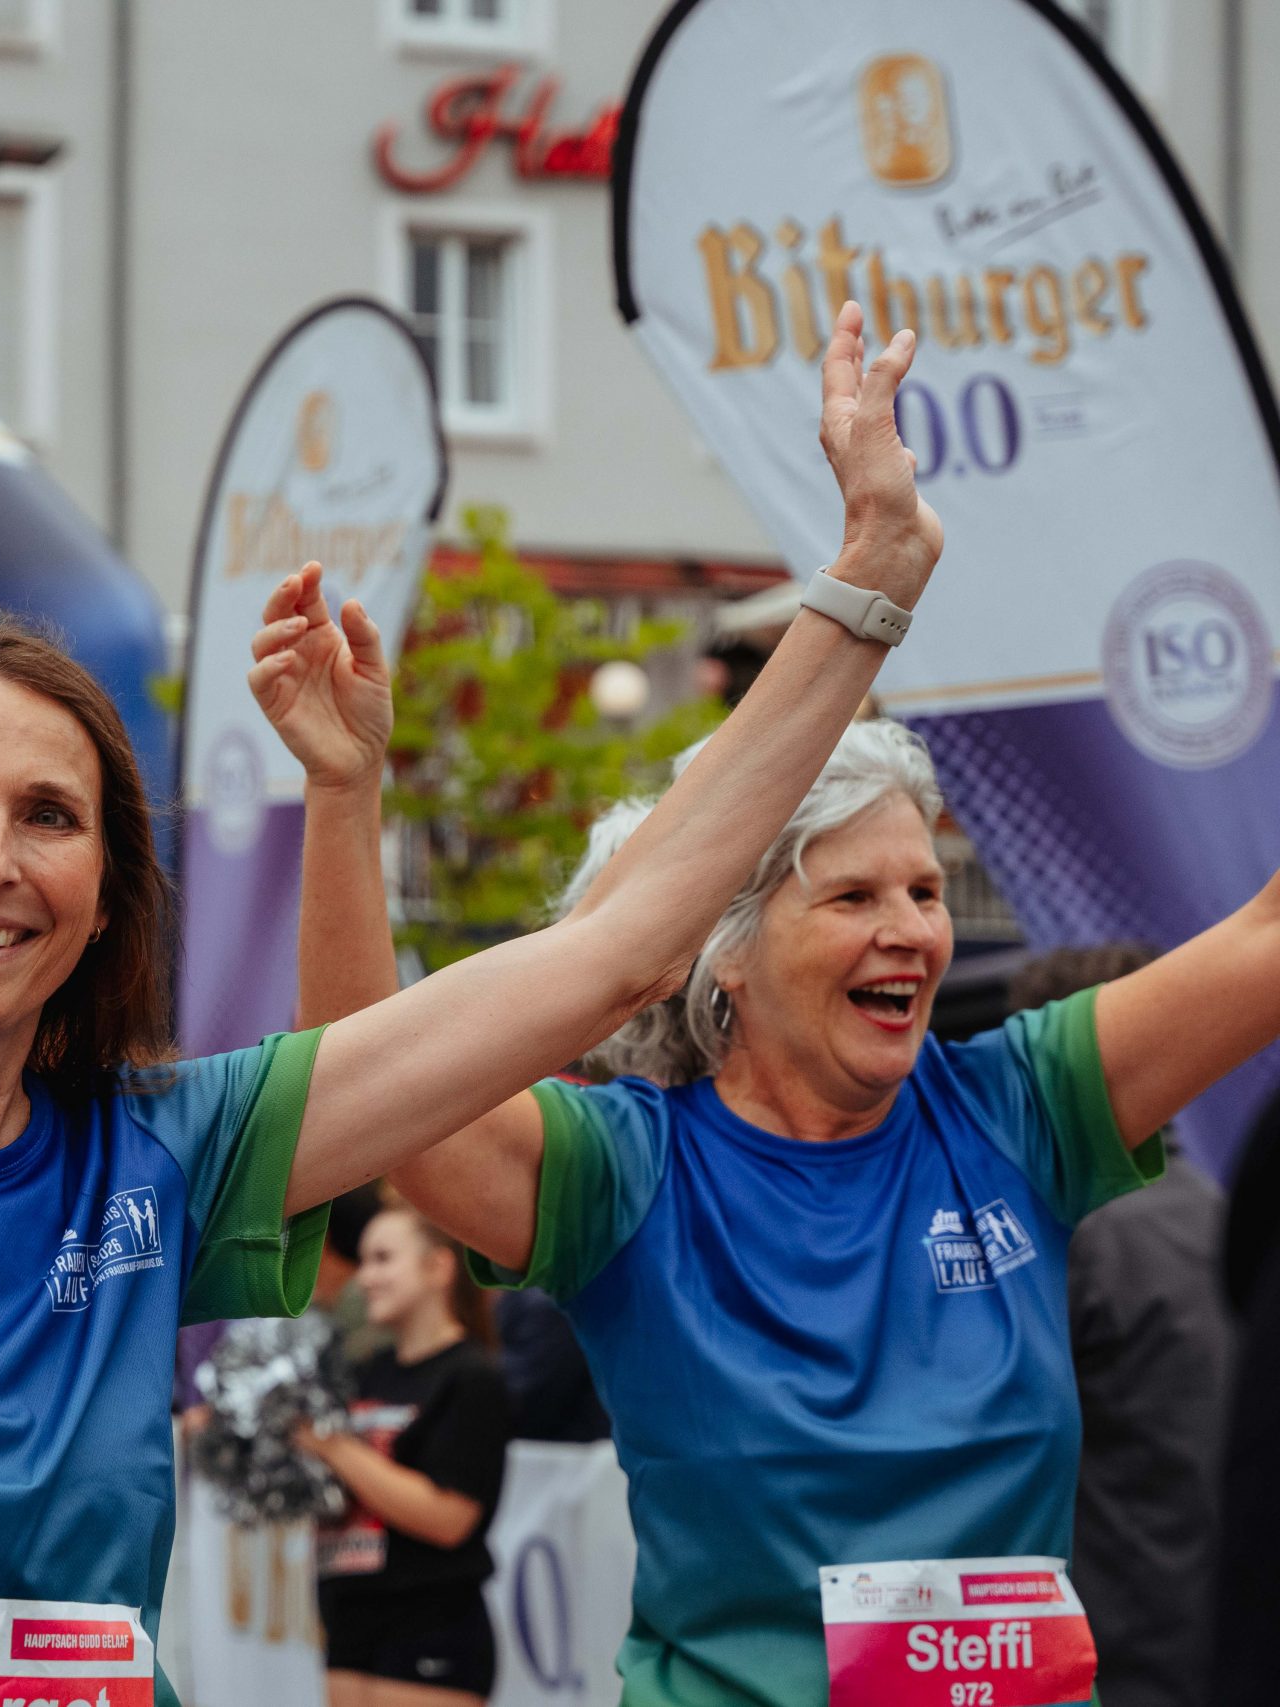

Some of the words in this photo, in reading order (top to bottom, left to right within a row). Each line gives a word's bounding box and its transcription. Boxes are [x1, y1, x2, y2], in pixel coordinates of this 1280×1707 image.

[697, 217, 1149, 373] Bitburger
[893, 371, 1023, 484] 0.0
[1144, 617, 1236, 680] ISO
[54, 1276, 88, 1304] LAUF
[24, 1633, 77, 1649] HAUPTSACH
[79, 1634, 100, 1648] GUDD
[102, 1634, 129, 1648] GELAAF
[906, 1622, 1033, 1672] Steffi
[950, 1682, 994, 1706] 972
